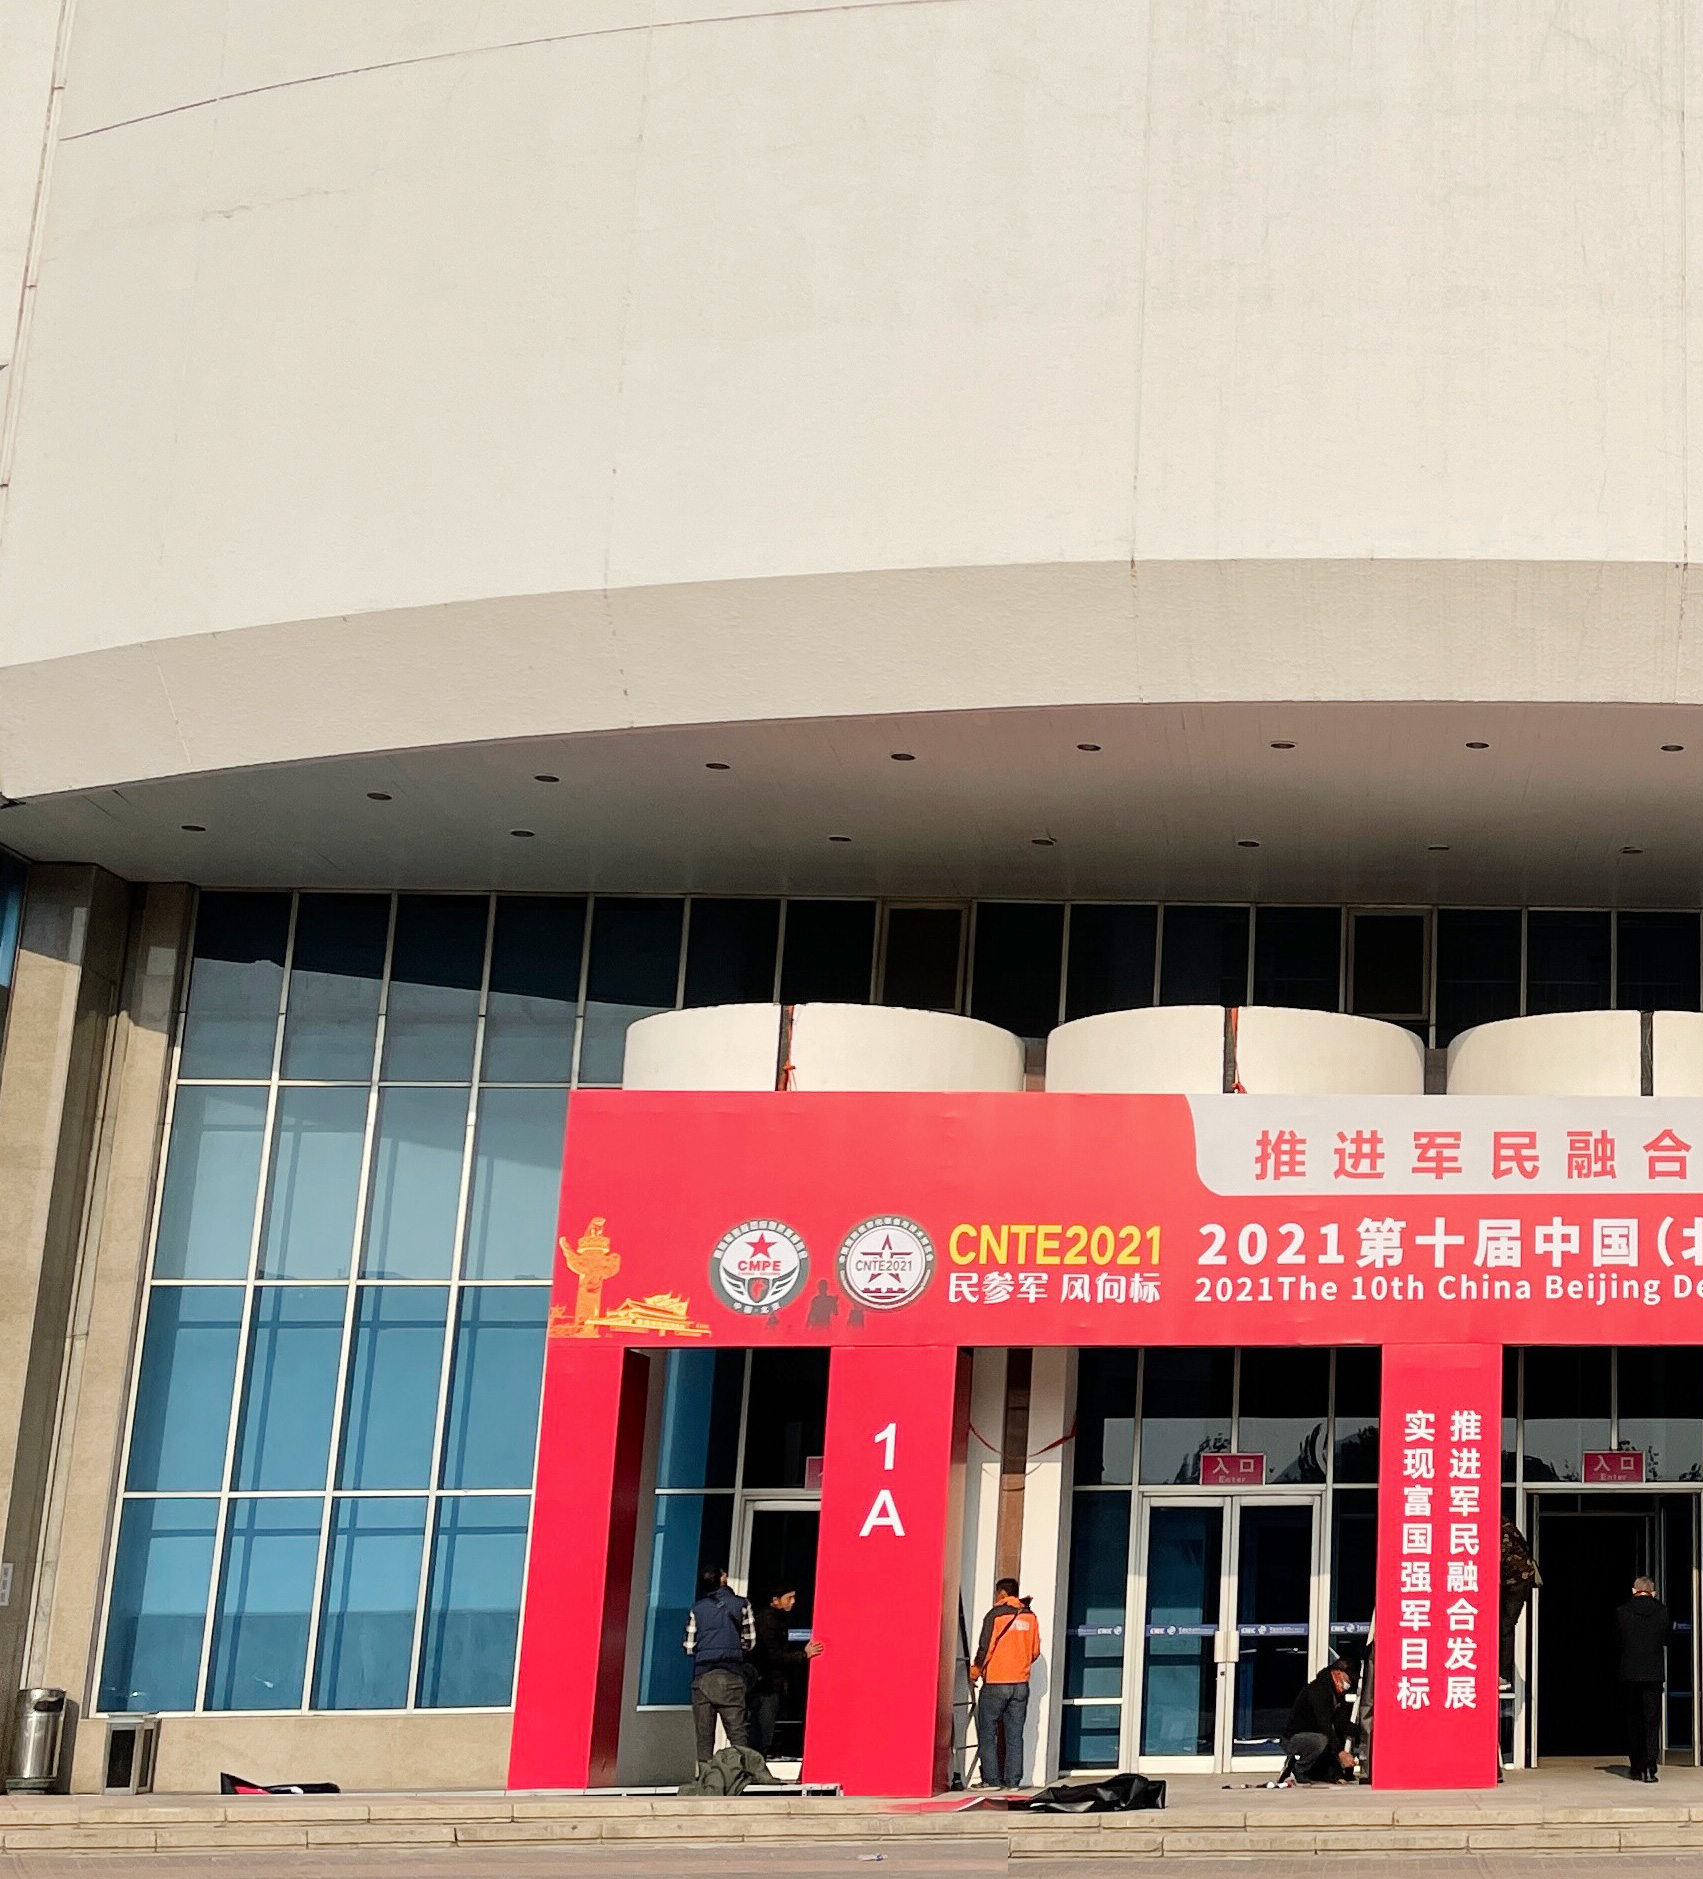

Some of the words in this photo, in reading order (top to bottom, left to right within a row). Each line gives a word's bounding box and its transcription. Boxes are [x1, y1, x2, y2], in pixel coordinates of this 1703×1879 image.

[949, 1223, 1161, 1266] CNTE2021
[737, 1260, 782, 1271] CMPE
[855, 1260, 912, 1272] CNTE2021
[949, 1272, 1050, 1304] 民参军
[1061, 1272, 1161, 1304] 风向标
[1195, 1275, 1338, 1303] 2021The
[1352, 1275, 1425, 1302] 10th
[1438, 1274, 1532, 1301] China
[1546, 1273, 1662, 1307] Beijing
[874, 1423, 897, 1471] 1
[1593, 1454, 1635, 1471] 入口
[1212, 1457, 1255, 1475] 入口
[860, 1489, 906, 1538] A
[1396, 1410, 1437, 1711] 实现富国强军目标
[1444, 1411, 1483, 1711] 推进军民融合发展
